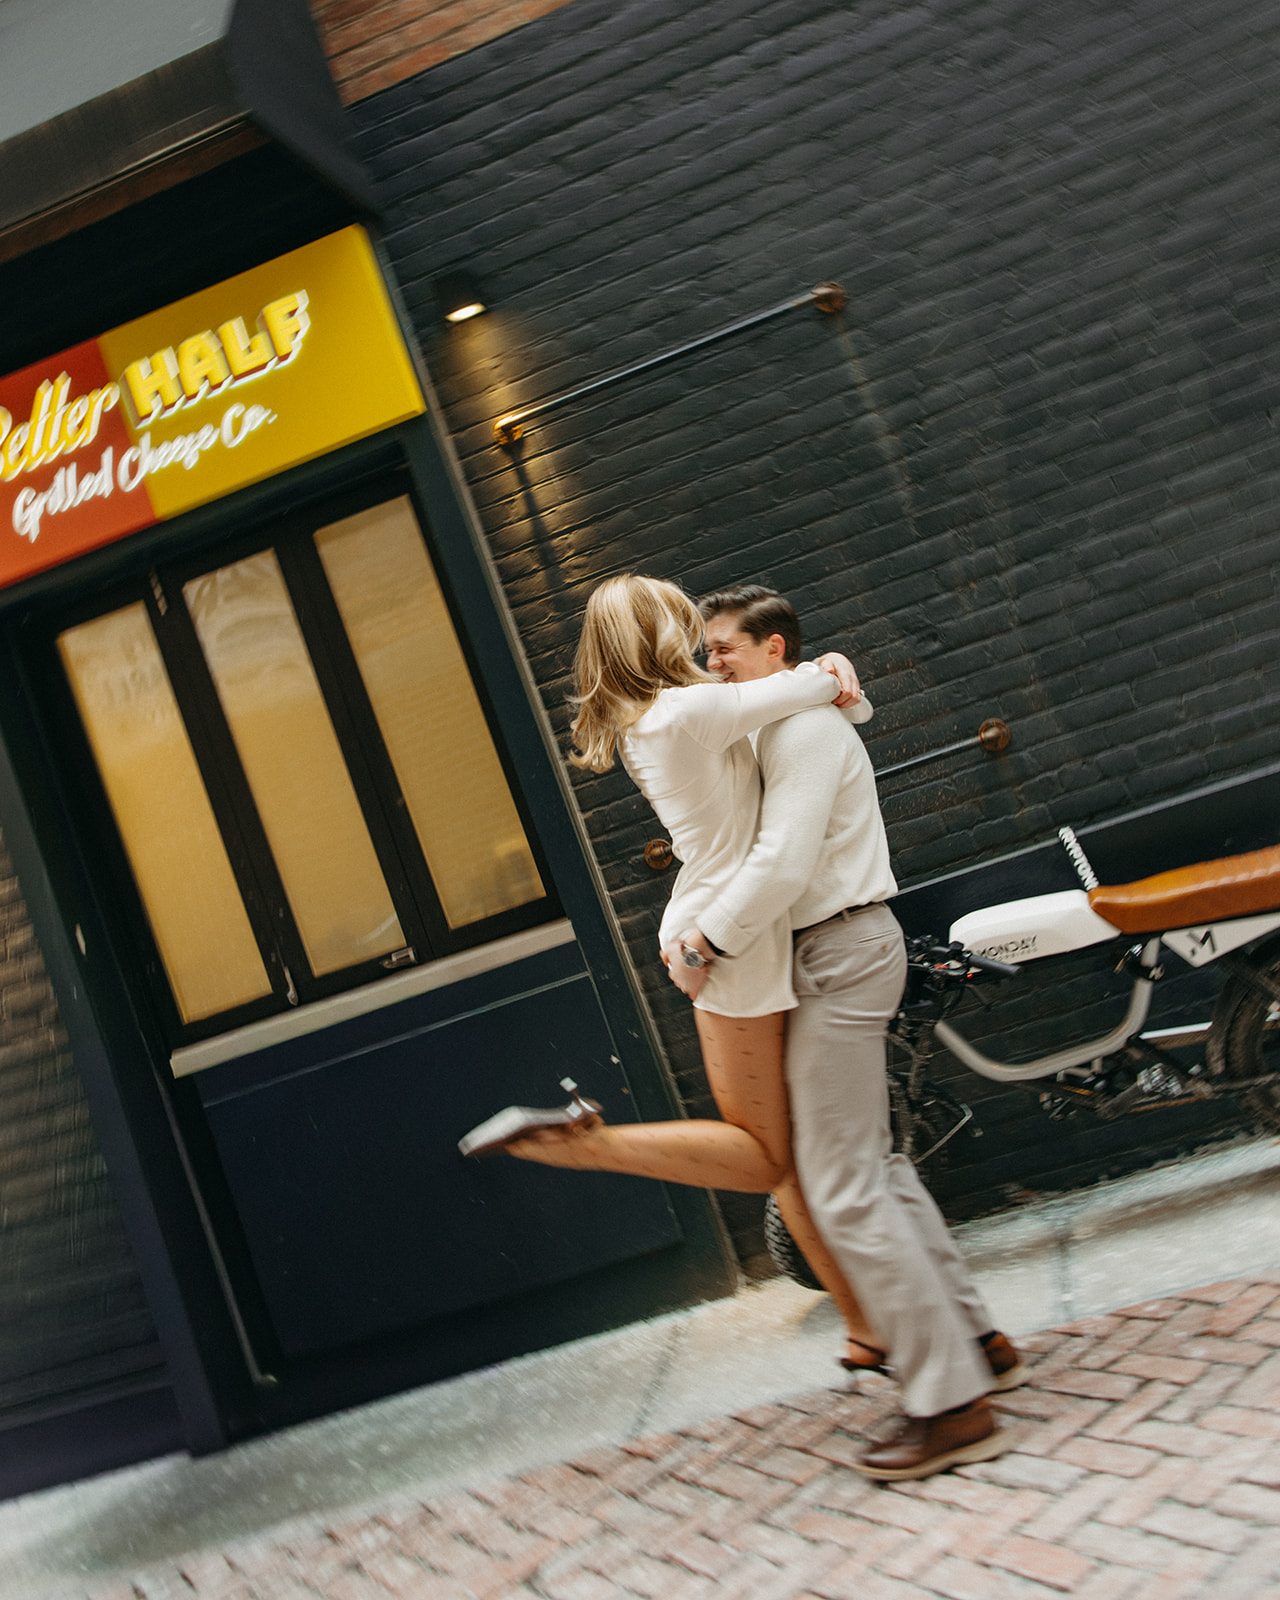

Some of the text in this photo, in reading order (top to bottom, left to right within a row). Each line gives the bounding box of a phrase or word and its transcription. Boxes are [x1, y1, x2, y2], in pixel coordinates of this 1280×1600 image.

[119, 290, 310, 429] HALF
[12, 446, 114, 543] Grilled
[220, 402, 278, 448] Co.
[976, 935, 1037, 958] MONDAY
